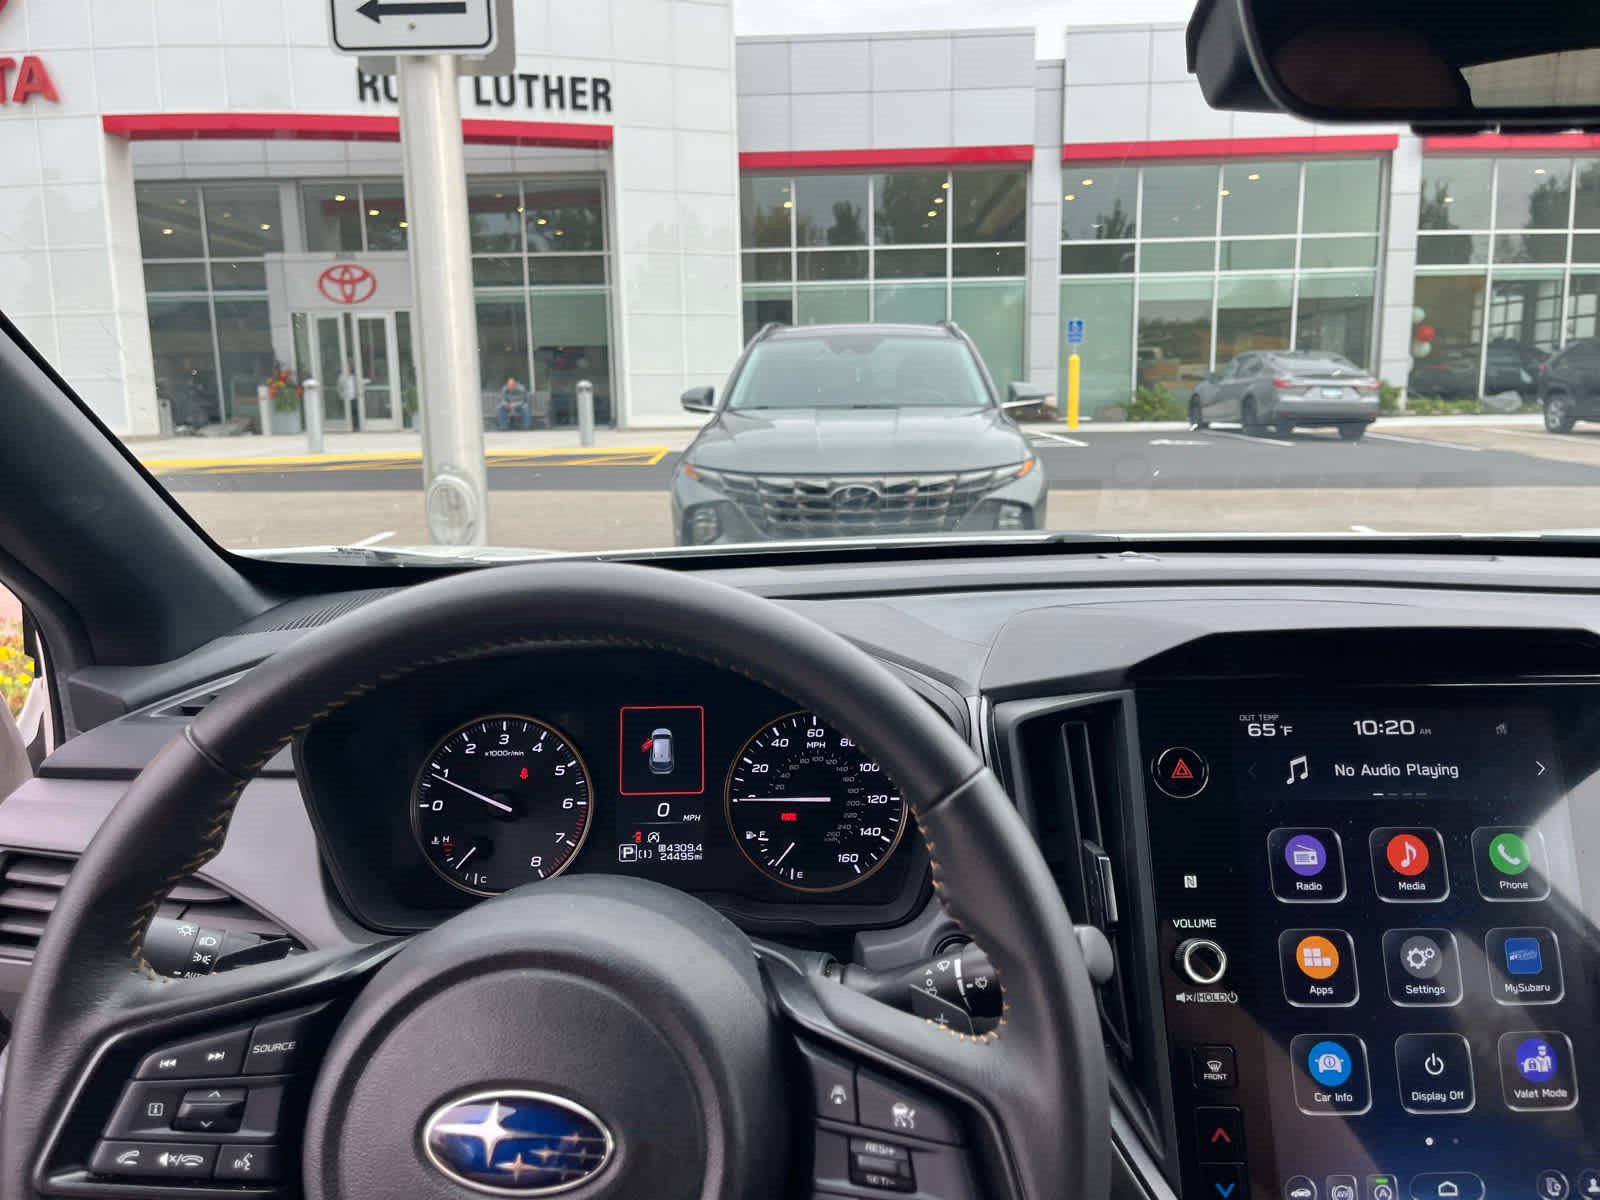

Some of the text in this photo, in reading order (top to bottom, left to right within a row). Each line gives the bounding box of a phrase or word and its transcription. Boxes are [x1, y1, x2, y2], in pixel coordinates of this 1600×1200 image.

[474, 73, 612, 112] LUTHER
[806, 728, 824, 738] 60
[1247, 723, 1276, 737] 65
[1353, 719, 1432, 736] 10:20 AM
[499, 734, 509, 745] 3
[771, 738, 789, 748] 40
[806, 741, 826, 749] MPH
[465, 743, 476, 754] 2
[532, 742, 543, 753] 4
[443, 768, 449, 778] 1
[554, 765, 566, 776] 5
[752, 764, 769, 773] 20
[859, 763, 880, 772] 100
[1334, 763, 1459, 779] No Audio Playing
[562, 798, 573, 809] 6
[867, 794, 888, 804] 120
[432, 800, 443, 811] 0
[657, 802, 670, 817] 0
[683, 814, 701, 822] MPH
[860, 827, 881, 837] 140
[555, 833, 565, 843] 7
[623, 846, 634, 859] P
[837, 853, 859, 863] 160
[530, 856, 542, 867] 8
[481, 876, 487, 884] C
[797, 871, 804, 879] E
[1295, 880, 1323, 892] Radio
[1398, 880, 1426, 892] Media
[1499, 879, 1528, 890] Phone
[1173, 919, 1217, 928] VOLUME
[1309, 984, 1334, 996] Apps
[1405, 984, 1446, 996] Settings
[1504, 983, 1550, 995] MySubaru
[252, 1041, 296, 1054] SOURCE
[1314, 1092, 1353, 1103] Car Info
[1411, 1090, 1464, 1103] Display Off
[1514, 1088, 1567, 1099] Valet Mode
